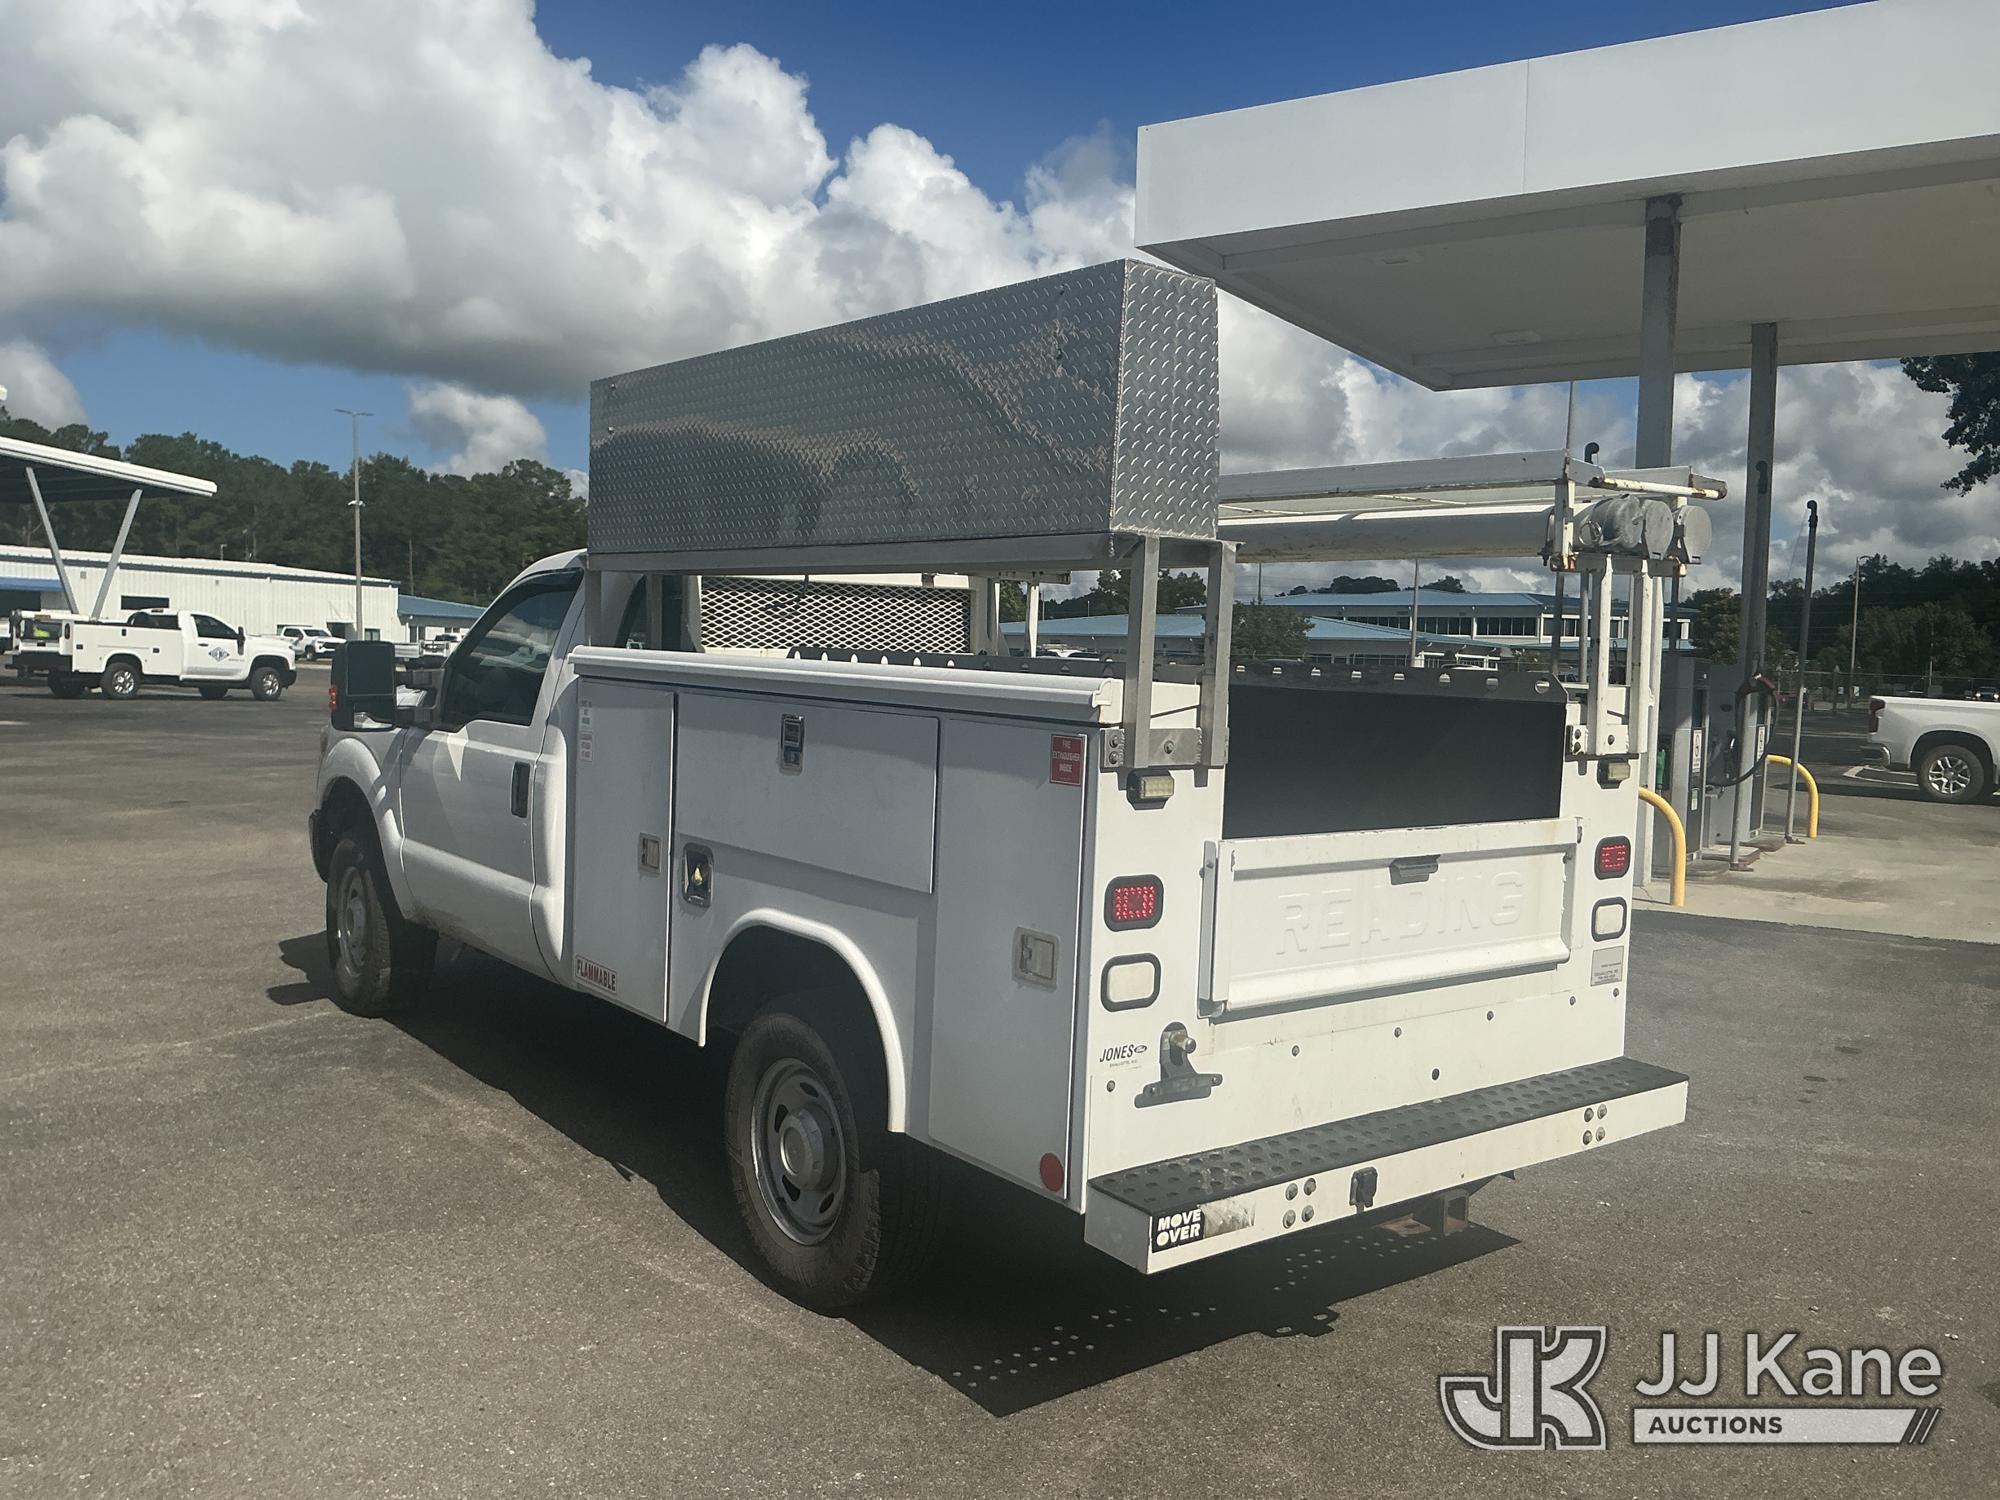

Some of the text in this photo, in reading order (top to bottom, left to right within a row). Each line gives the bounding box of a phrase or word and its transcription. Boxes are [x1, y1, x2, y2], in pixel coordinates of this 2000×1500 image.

[1276, 871, 1524, 956] READING
[576, 959, 616, 992] FLAMMABLE
[1099, 1044, 1134, 1063] JONES
[1157, 1208, 1202, 1232] MOVE
[1156, 1223, 1201, 1247] OVER
